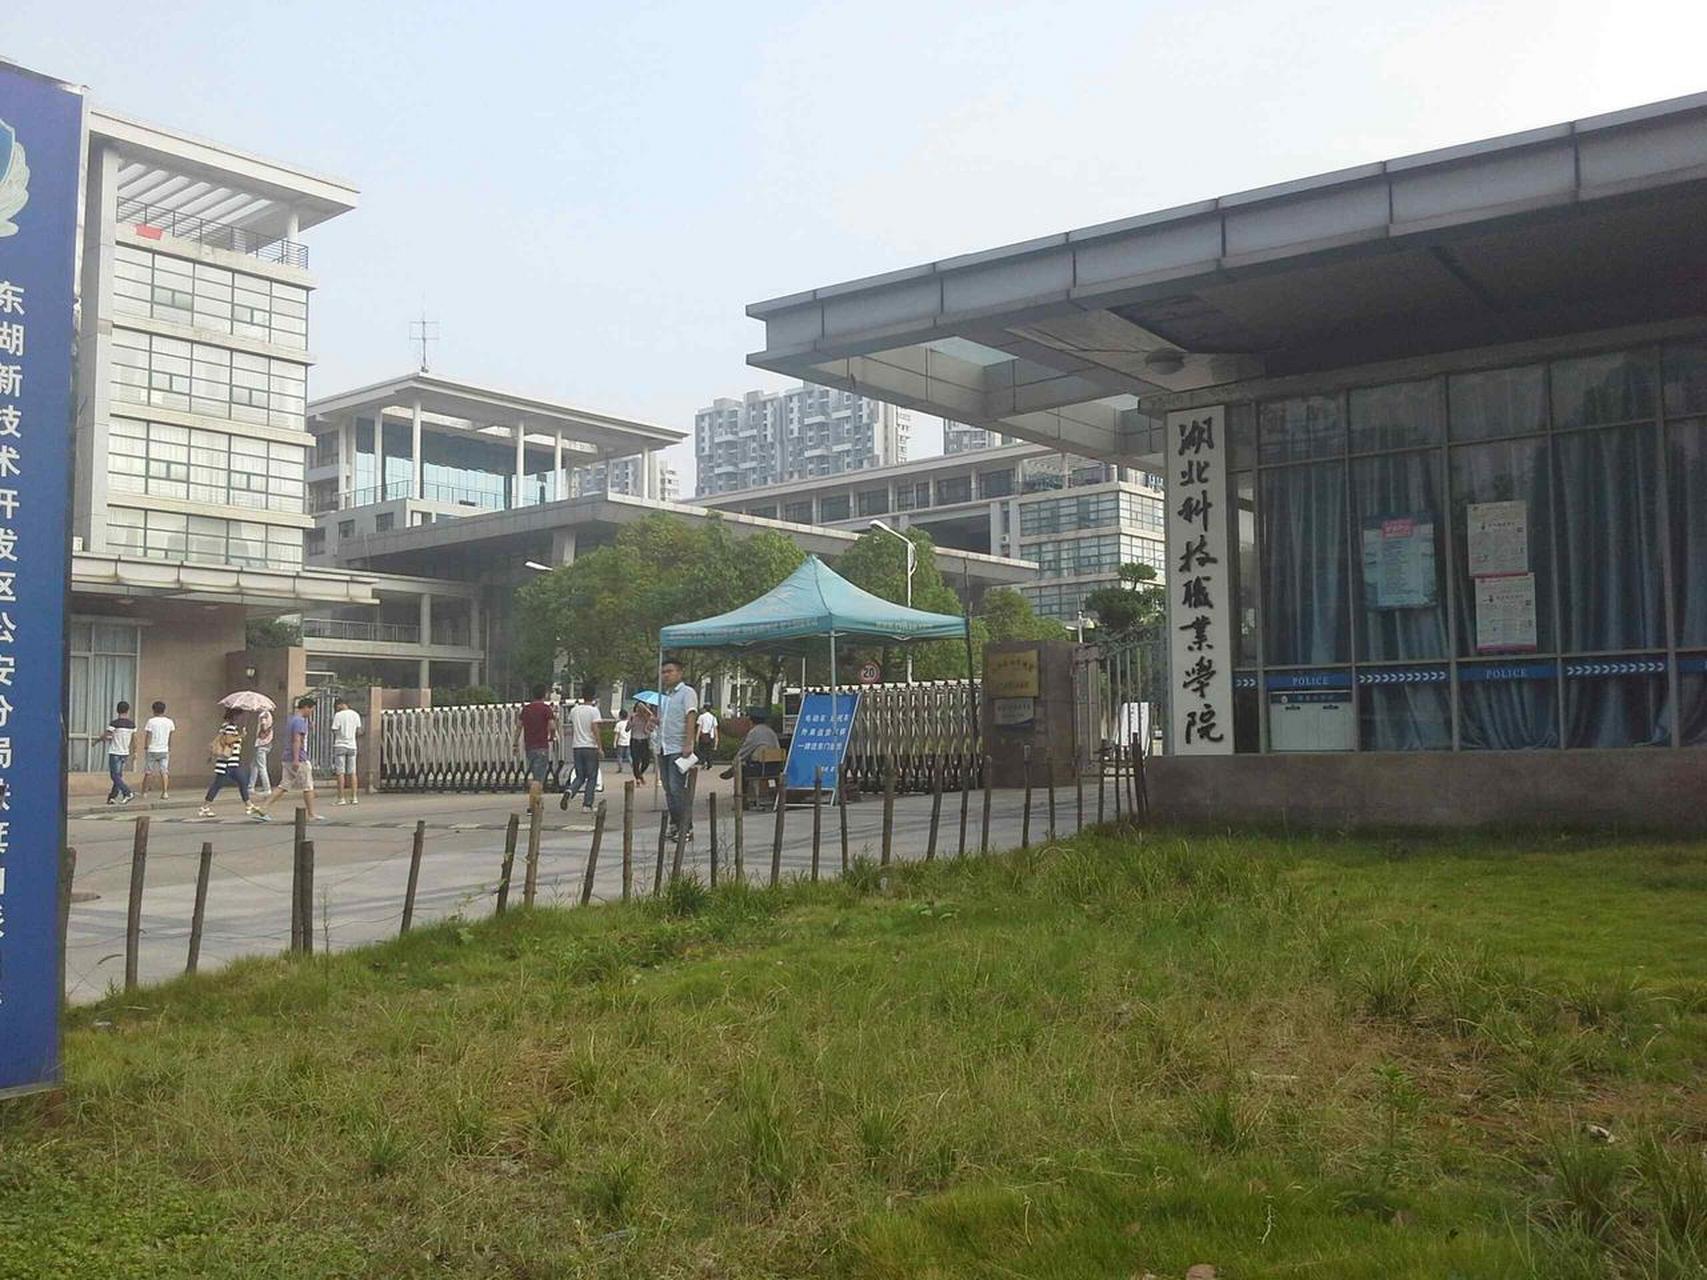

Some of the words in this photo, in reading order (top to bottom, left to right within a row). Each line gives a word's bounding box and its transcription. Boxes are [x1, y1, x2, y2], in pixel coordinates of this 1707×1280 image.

[863, 668, 876, 678] 20
[1486, 667, 1528, 680] POLICE
[1291, 676, 1330, 687] POLICE
